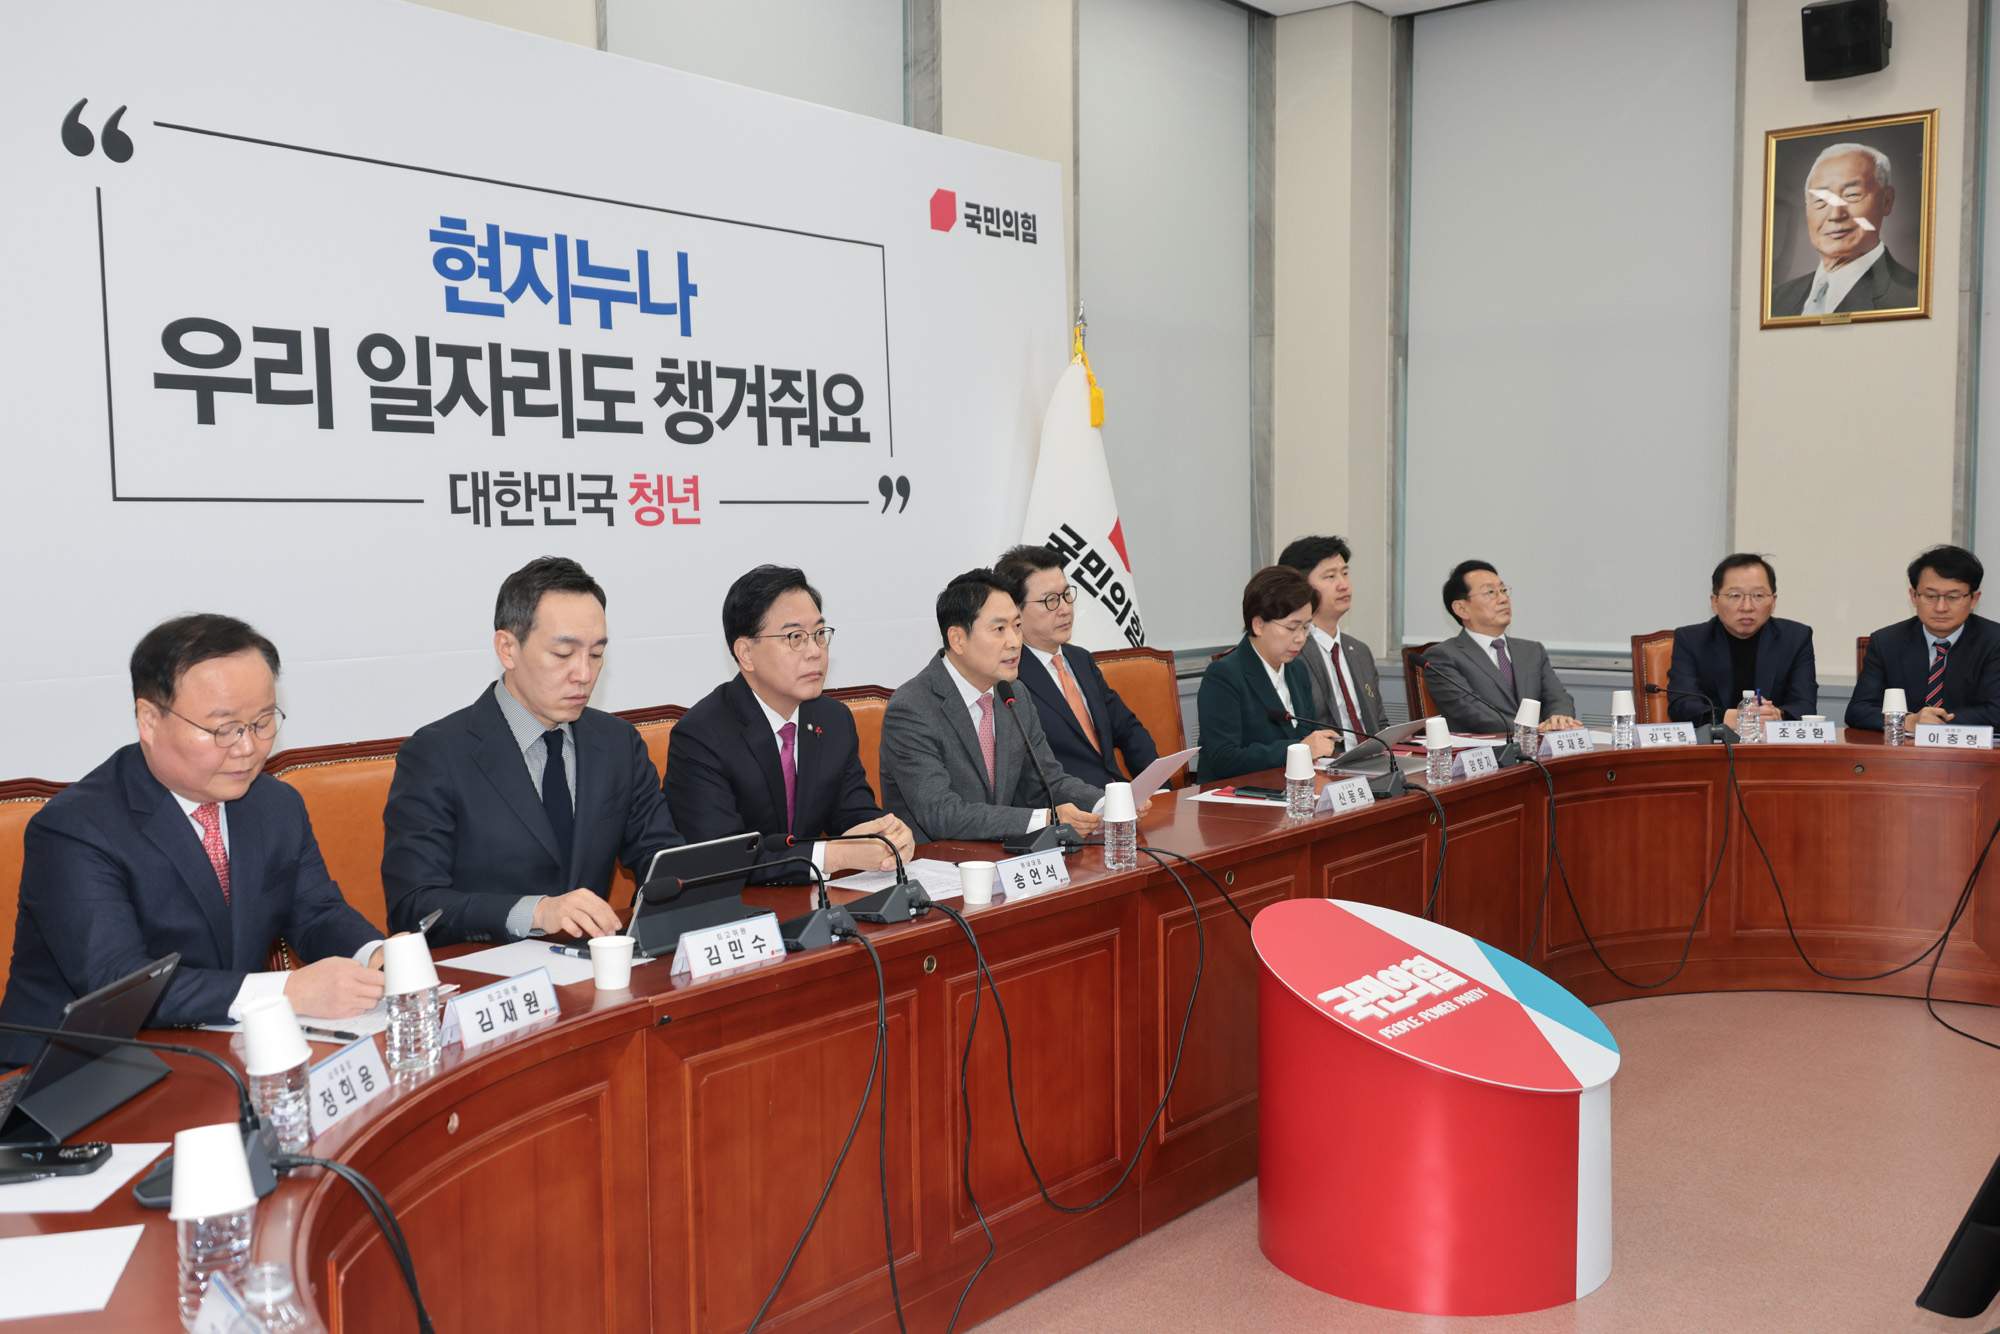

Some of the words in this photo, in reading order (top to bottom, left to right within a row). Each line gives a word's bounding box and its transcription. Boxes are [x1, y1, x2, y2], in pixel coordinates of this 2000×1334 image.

[964, 201, 1038, 245] 국민의힘
[429, 215, 699, 338] 현지누나
[153, 316, 335, 430] 우리
[356, 332, 644, 440] 일자리도
[653, 357, 871, 449] 챙겨줘요
[448, 470, 618, 528] 대한민국
[627, 473, 701, 527] 청년
[1779, 727, 1824, 739] 조승환
[1013, 864, 1058, 889] 송언석
[704, 934, 767, 967] 김민수
[475, 990, 541, 1033] 김재원
[1316, 954, 1469, 1022] 국민의힘
[1378, 1015, 1425, 1040] PEOPLE
[1418, 1000, 1460, 1022] POWER
[1453, 986, 1489, 1007] PARTY
[319, 1065, 375, 1117] 정희용
